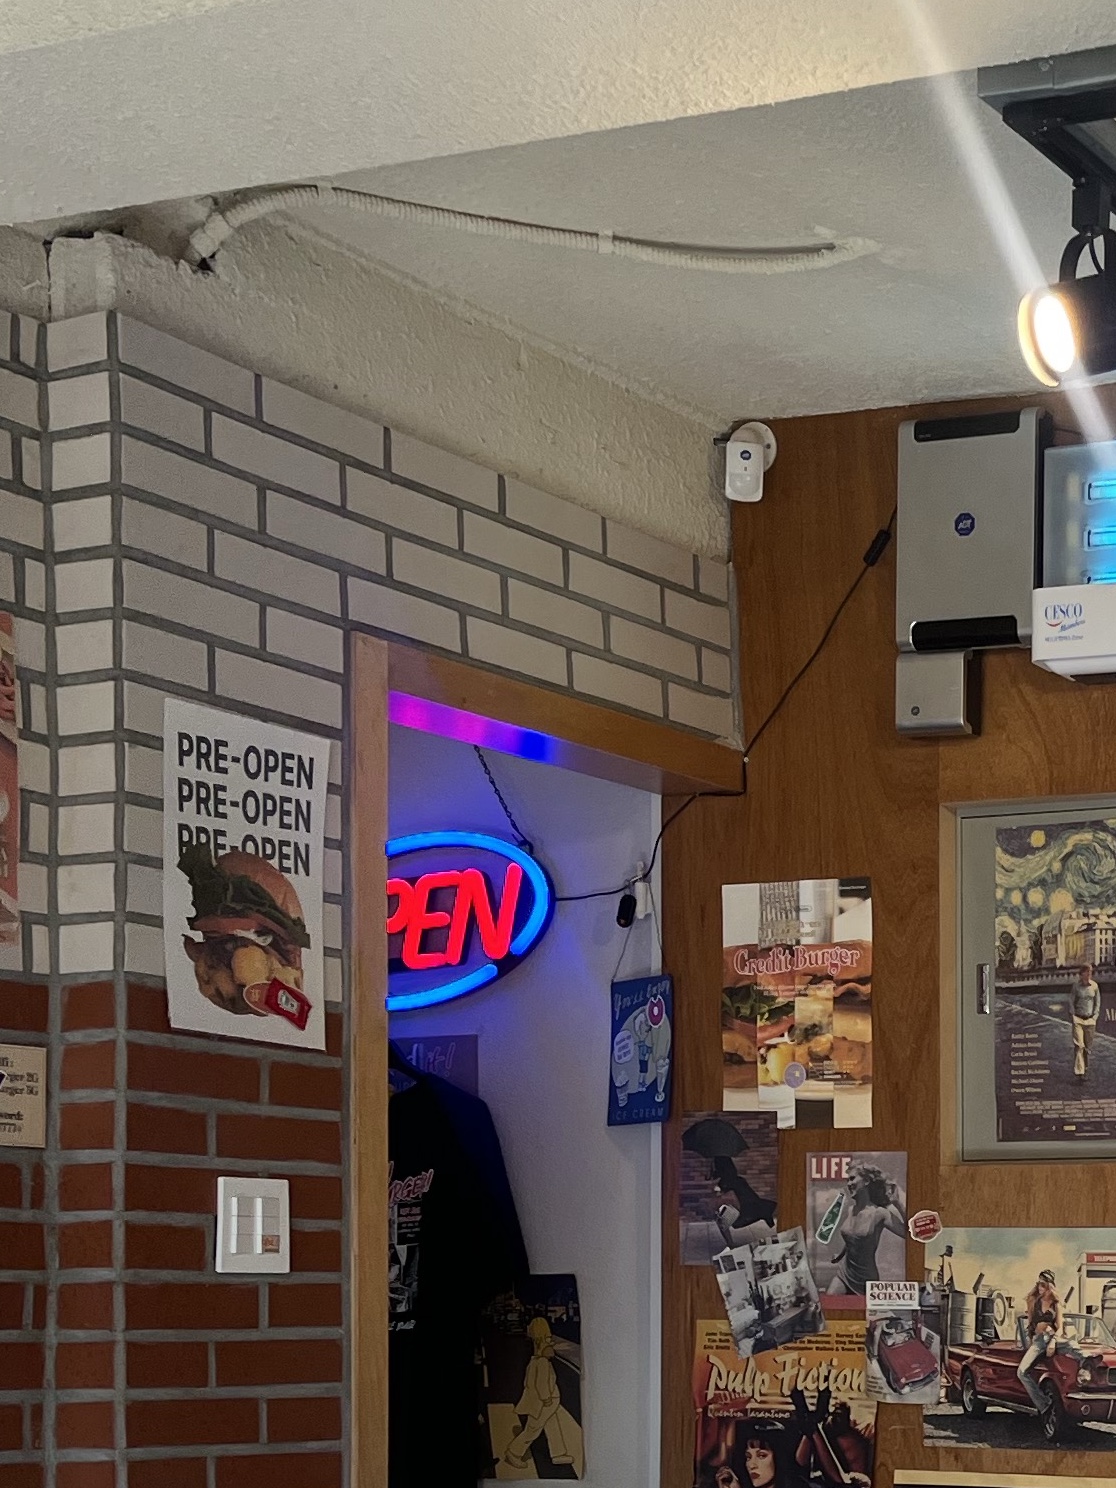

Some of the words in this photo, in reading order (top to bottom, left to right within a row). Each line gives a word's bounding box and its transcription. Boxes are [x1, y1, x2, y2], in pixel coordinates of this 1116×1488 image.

[1045, 603, 1082, 620] CESCO
[177, 731, 314, 790] PRE-OPEN
[177, 777, 311, 833] PRE-OPEN
[734, 947, 791, 975] Credit
[793, 945, 861, 976] Burger
[811, 1157, 850, 1179] LIFE
[869, 1282, 916, 1292] POPULAR
[869, 1292, 916, 1302] SCIENCE
[706, 1354, 771, 1403] Pulp
[773, 1352, 867, 1397] Fiction
[708, 1403, 744, 1418] Quentin
[747, 1405, 790, 1419] Tarantino
